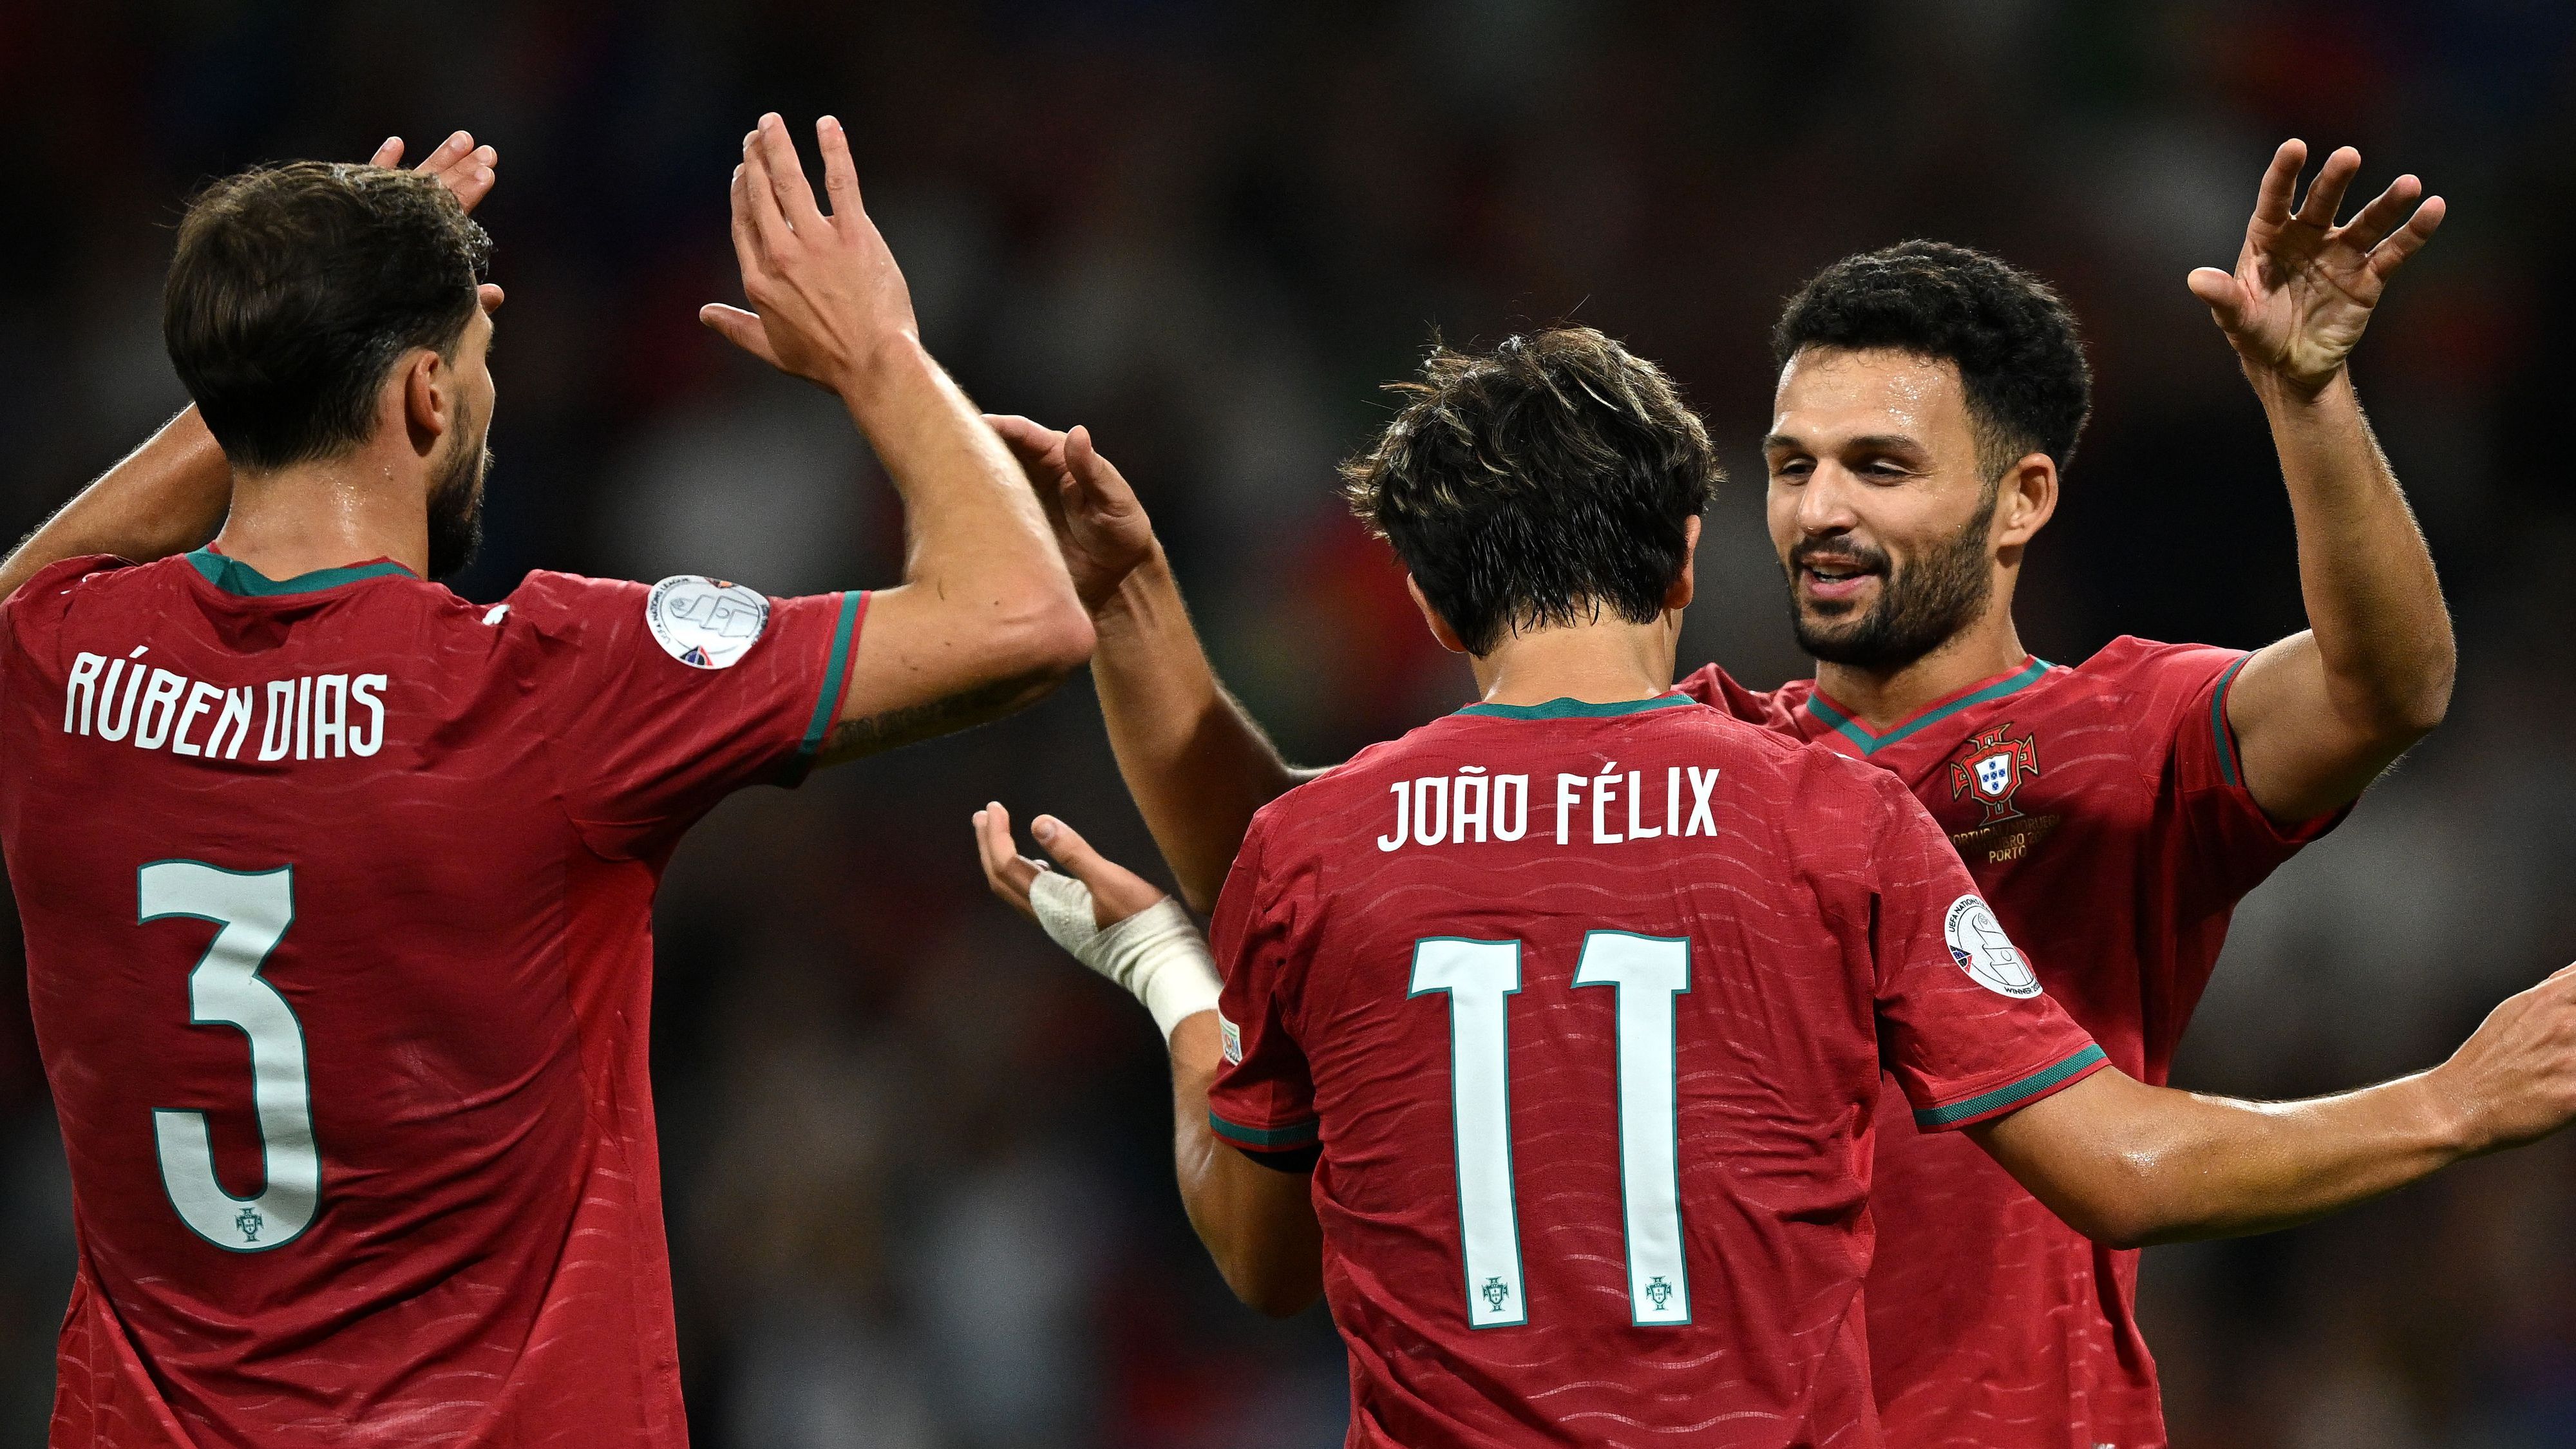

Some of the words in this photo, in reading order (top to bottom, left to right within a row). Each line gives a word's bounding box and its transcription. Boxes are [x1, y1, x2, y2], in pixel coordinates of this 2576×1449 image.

[64, 645, 253, 760] RÚBEN
[257, 673, 388, 762] DIAS
[1377, 765, 1529, 852] JOÃO
[1556, 761, 1720, 846] FÉLIX
[1989, 844, 2027, 864] PORTO
[1948, 914, 1959, 933] UEFA
[137, 858, 322, 1253] 3
[1405, 929, 1692, 1330] 11
